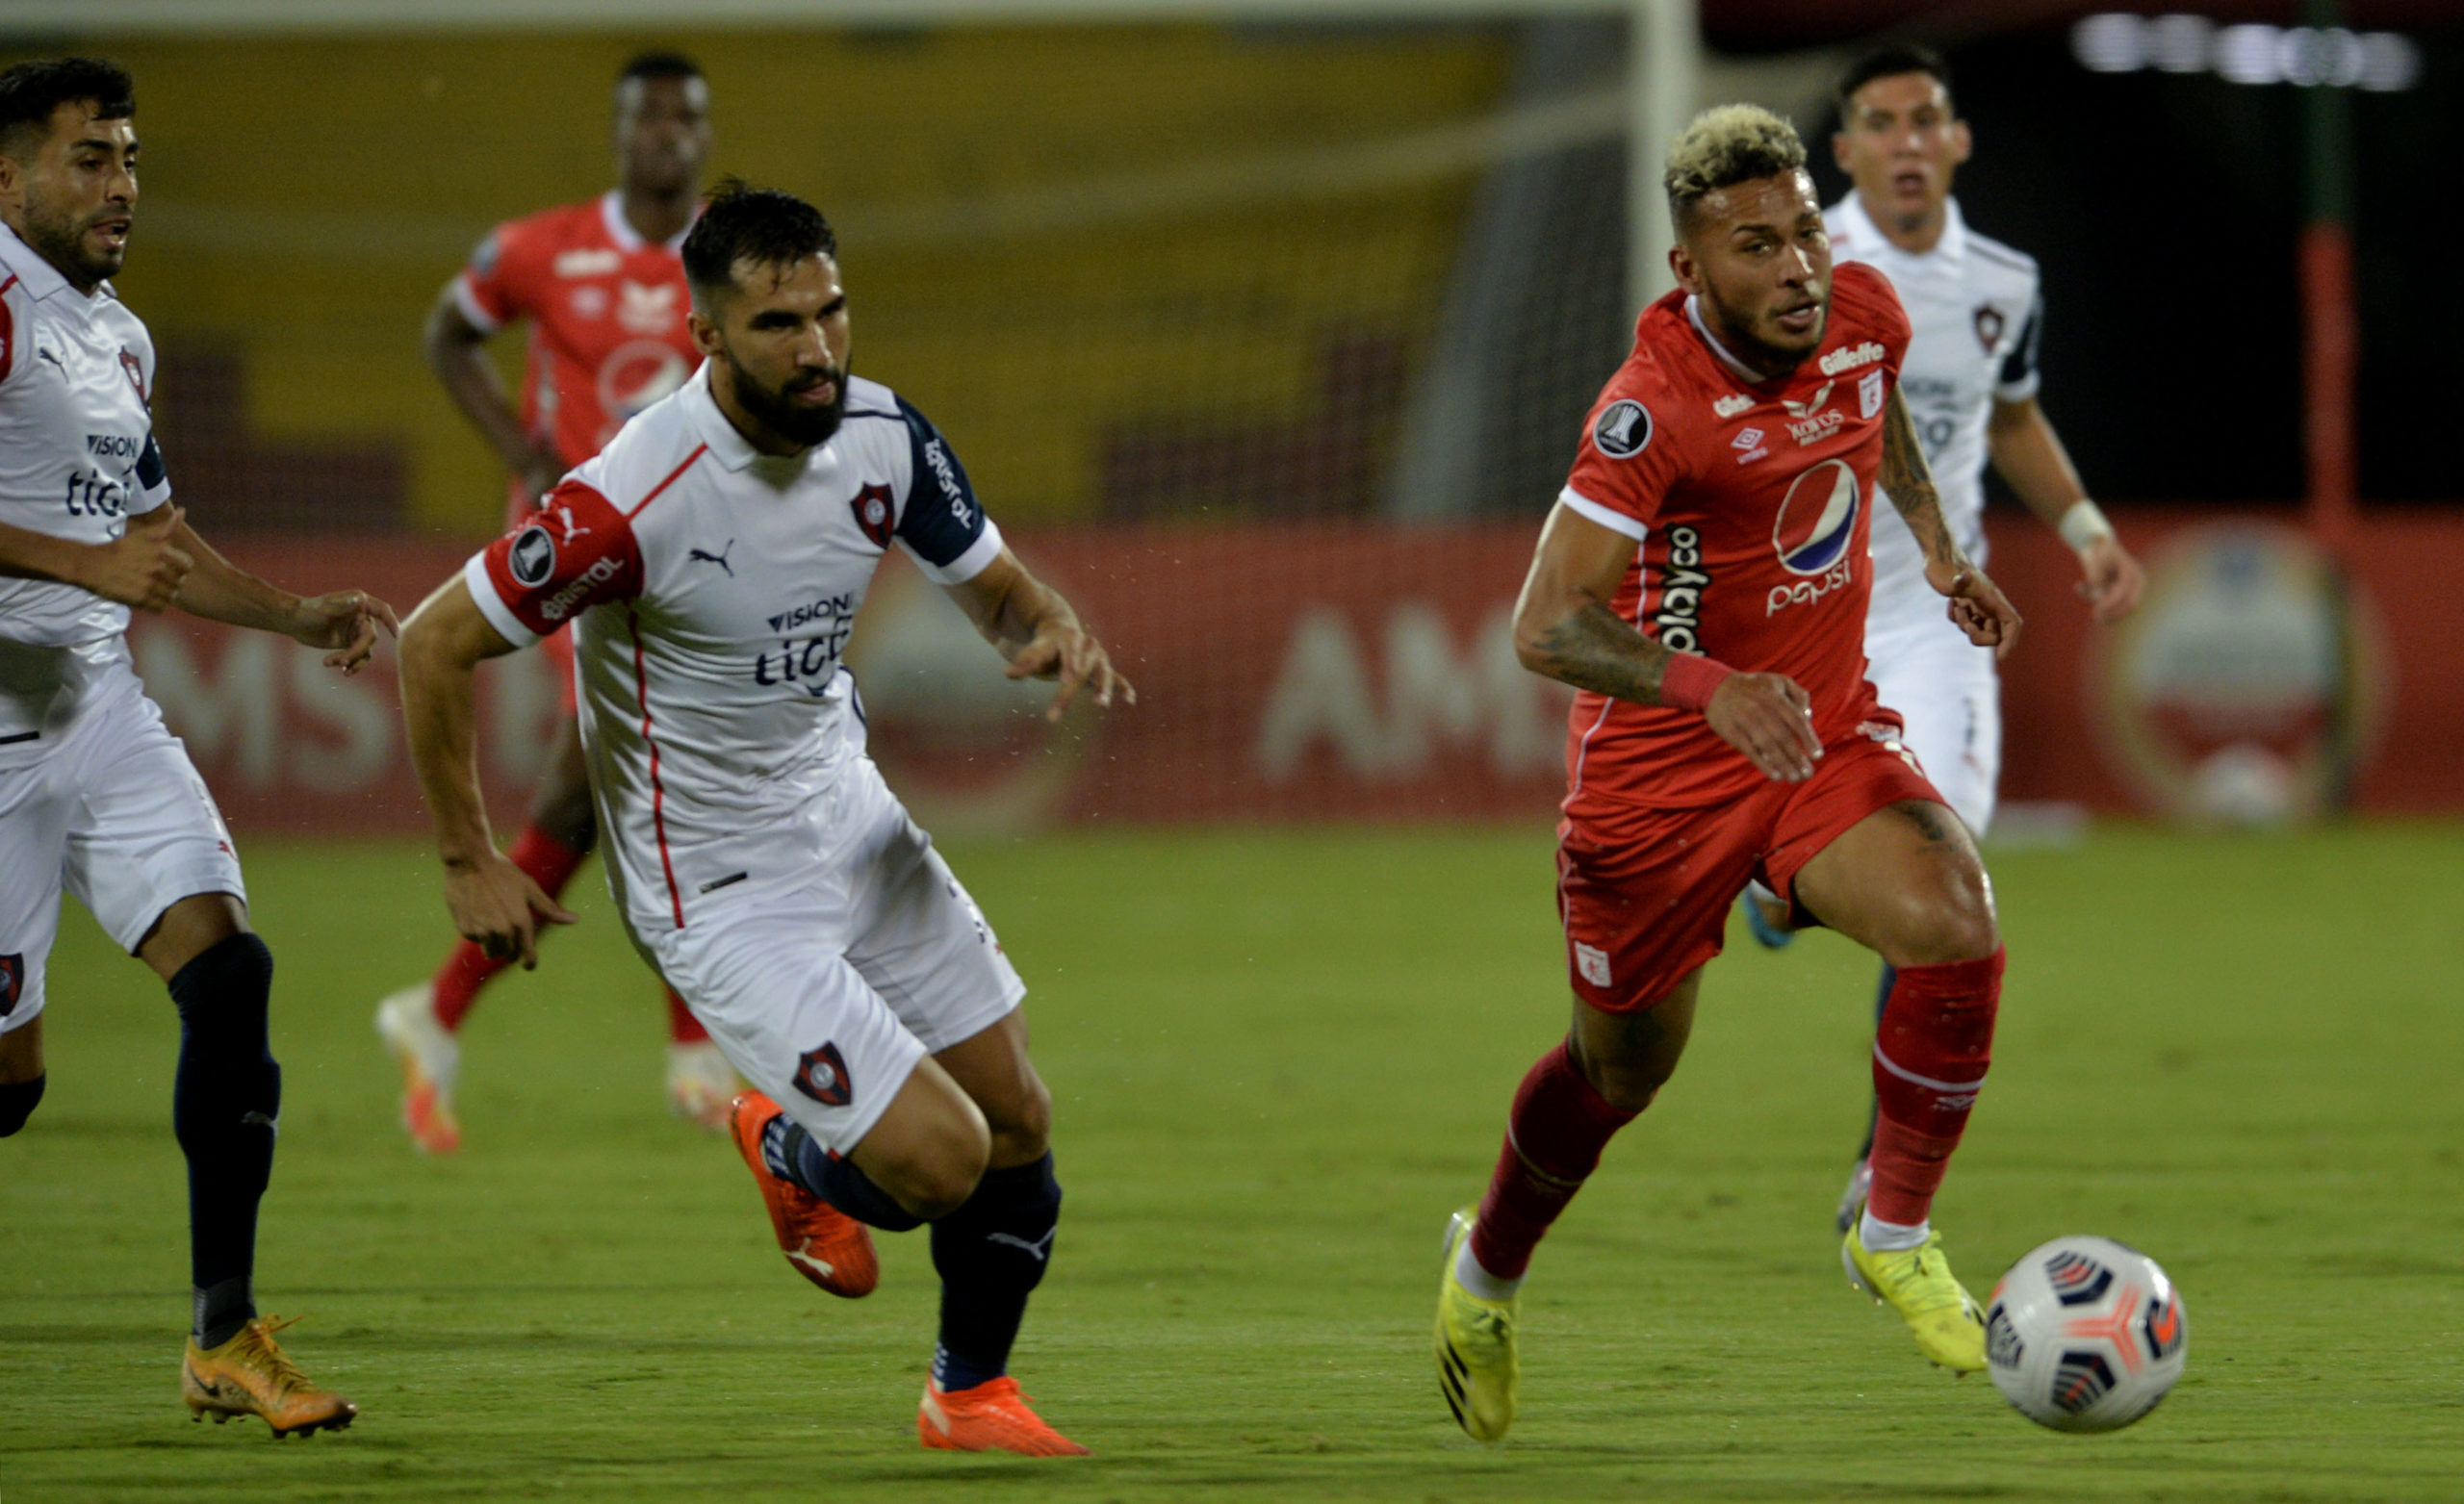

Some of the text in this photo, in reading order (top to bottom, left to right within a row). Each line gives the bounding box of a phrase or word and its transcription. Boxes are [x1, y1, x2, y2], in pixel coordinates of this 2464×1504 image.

[66, 467, 133, 539] tig
[766, 591, 853, 634] VISION
[1765, 555, 1852, 619] pepsi
